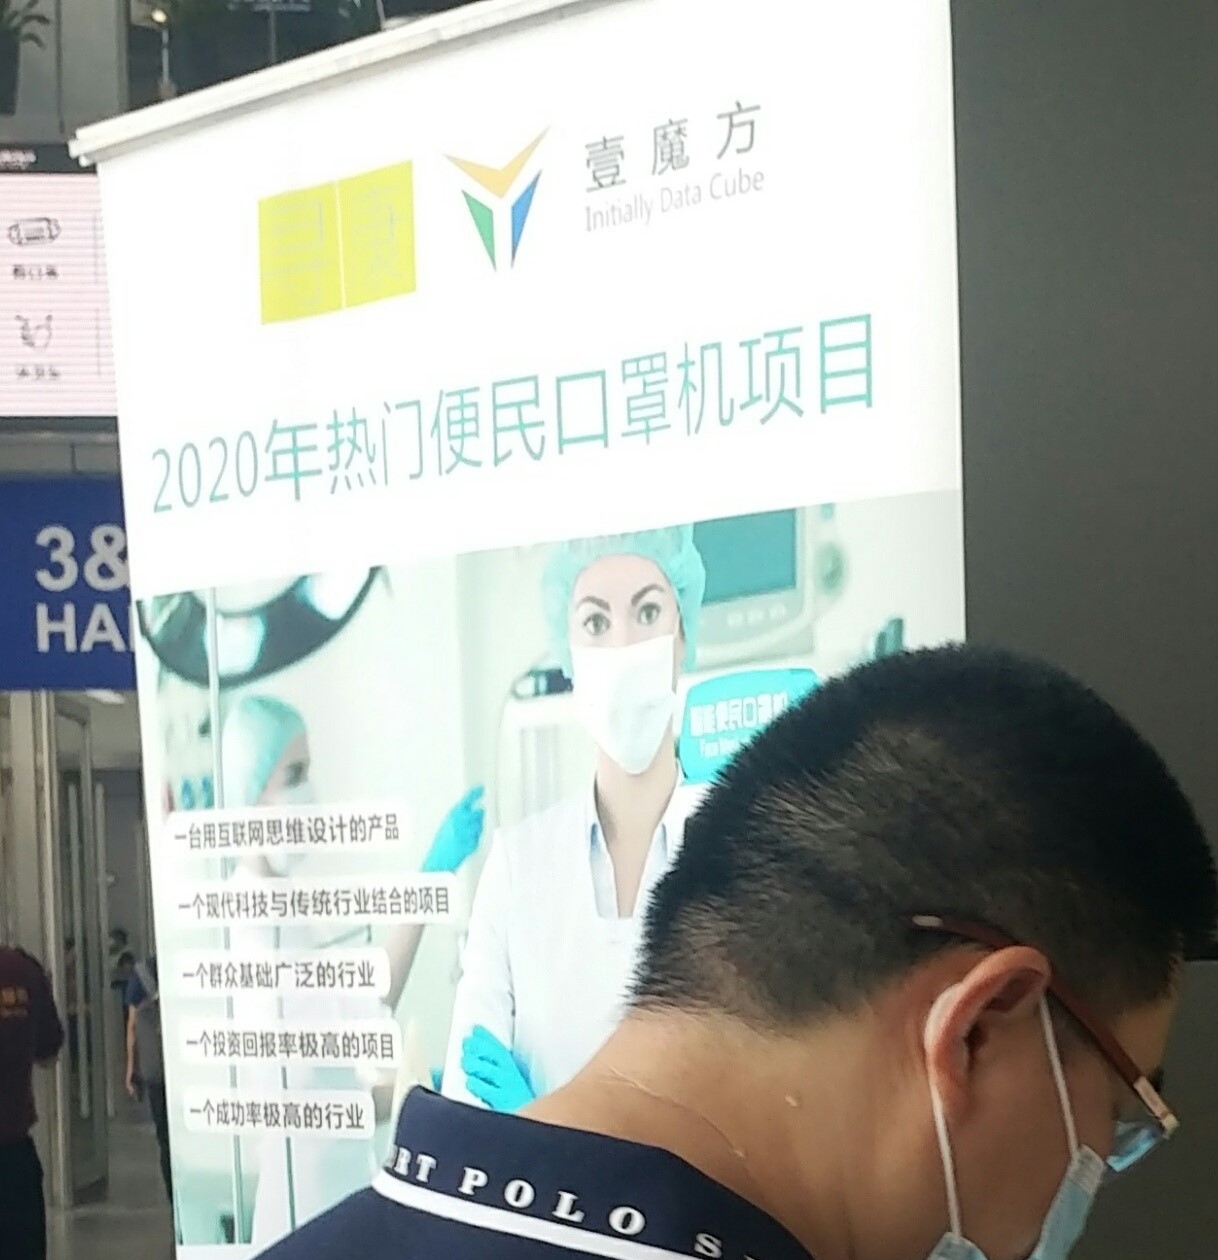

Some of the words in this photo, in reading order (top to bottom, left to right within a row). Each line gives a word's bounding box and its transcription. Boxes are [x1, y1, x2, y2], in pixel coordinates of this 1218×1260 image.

[585, 101, 761, 192] 壹魔方
[585, 194, 653, 232] Initially
[660, 184, 702, 214] Data
[709, 167, 765, 202] Cube
[152, 312, 874, 513] 2020年热门便民口罩机项目
[174, 813, 400, 851] 一台用互联网思维设计的产品
[178, 886, 450, 920] 一个现代科技与传统行业结合的项目
[182, 960, 376, 989] 一个群众基础广泛的行业
[186, 1030, 395, 1060] 一个投资回报率极高的项目
[189, 1099, 365, 1130] 一个成功率极高的行业
[389, 1146, 437, 1182] RT
[457, 1166, 646, 1236] POLO
